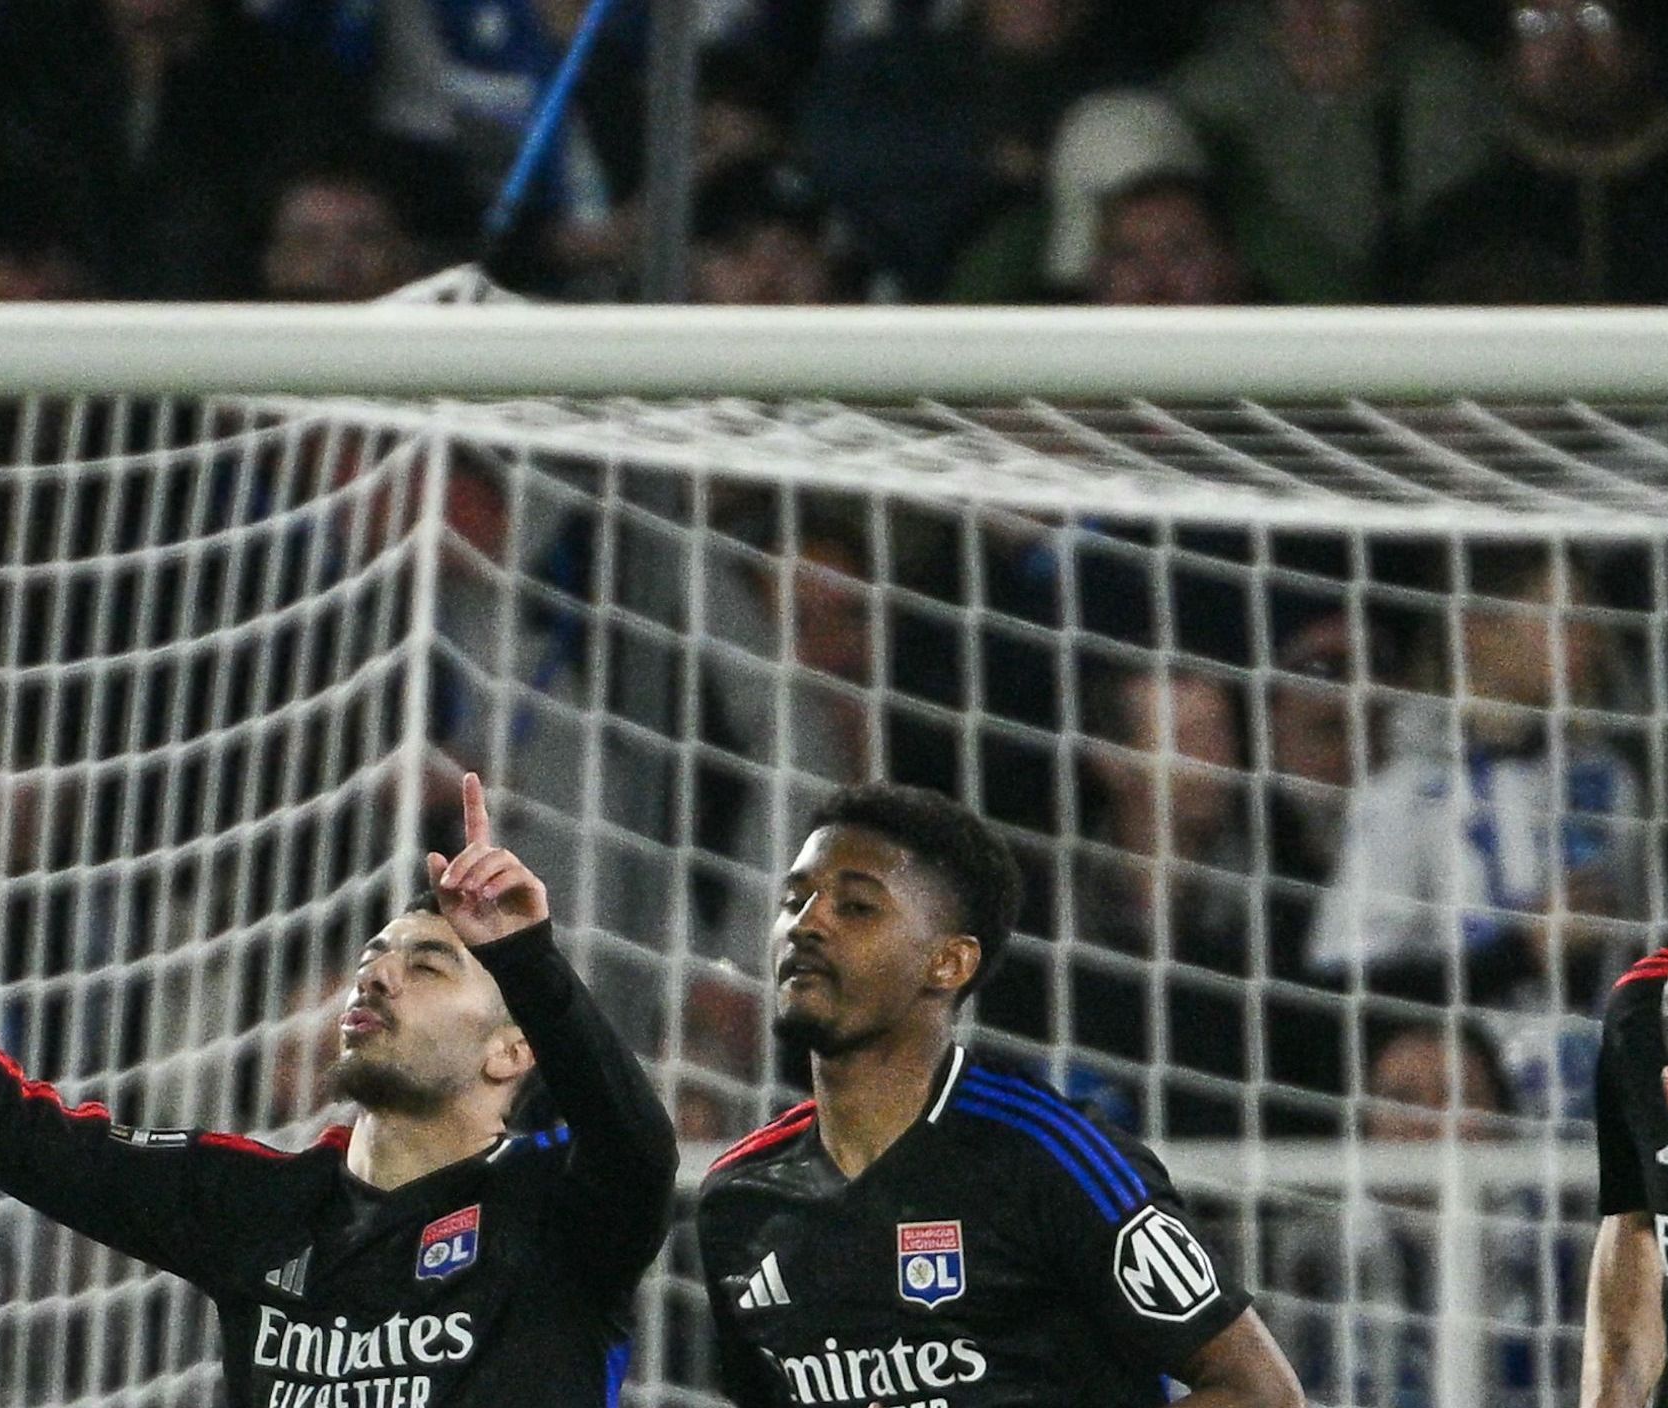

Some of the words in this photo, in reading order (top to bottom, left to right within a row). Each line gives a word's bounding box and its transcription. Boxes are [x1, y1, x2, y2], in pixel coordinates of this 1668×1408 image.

[422, 1234, 470, 1269] OL
[905, 1255, 958, 1290] OL
[1122, 1213, 1213, 1309] MG
[253, 1304, 475, 1378] Emirates
[782, 1336, 988, 1404] mirates
